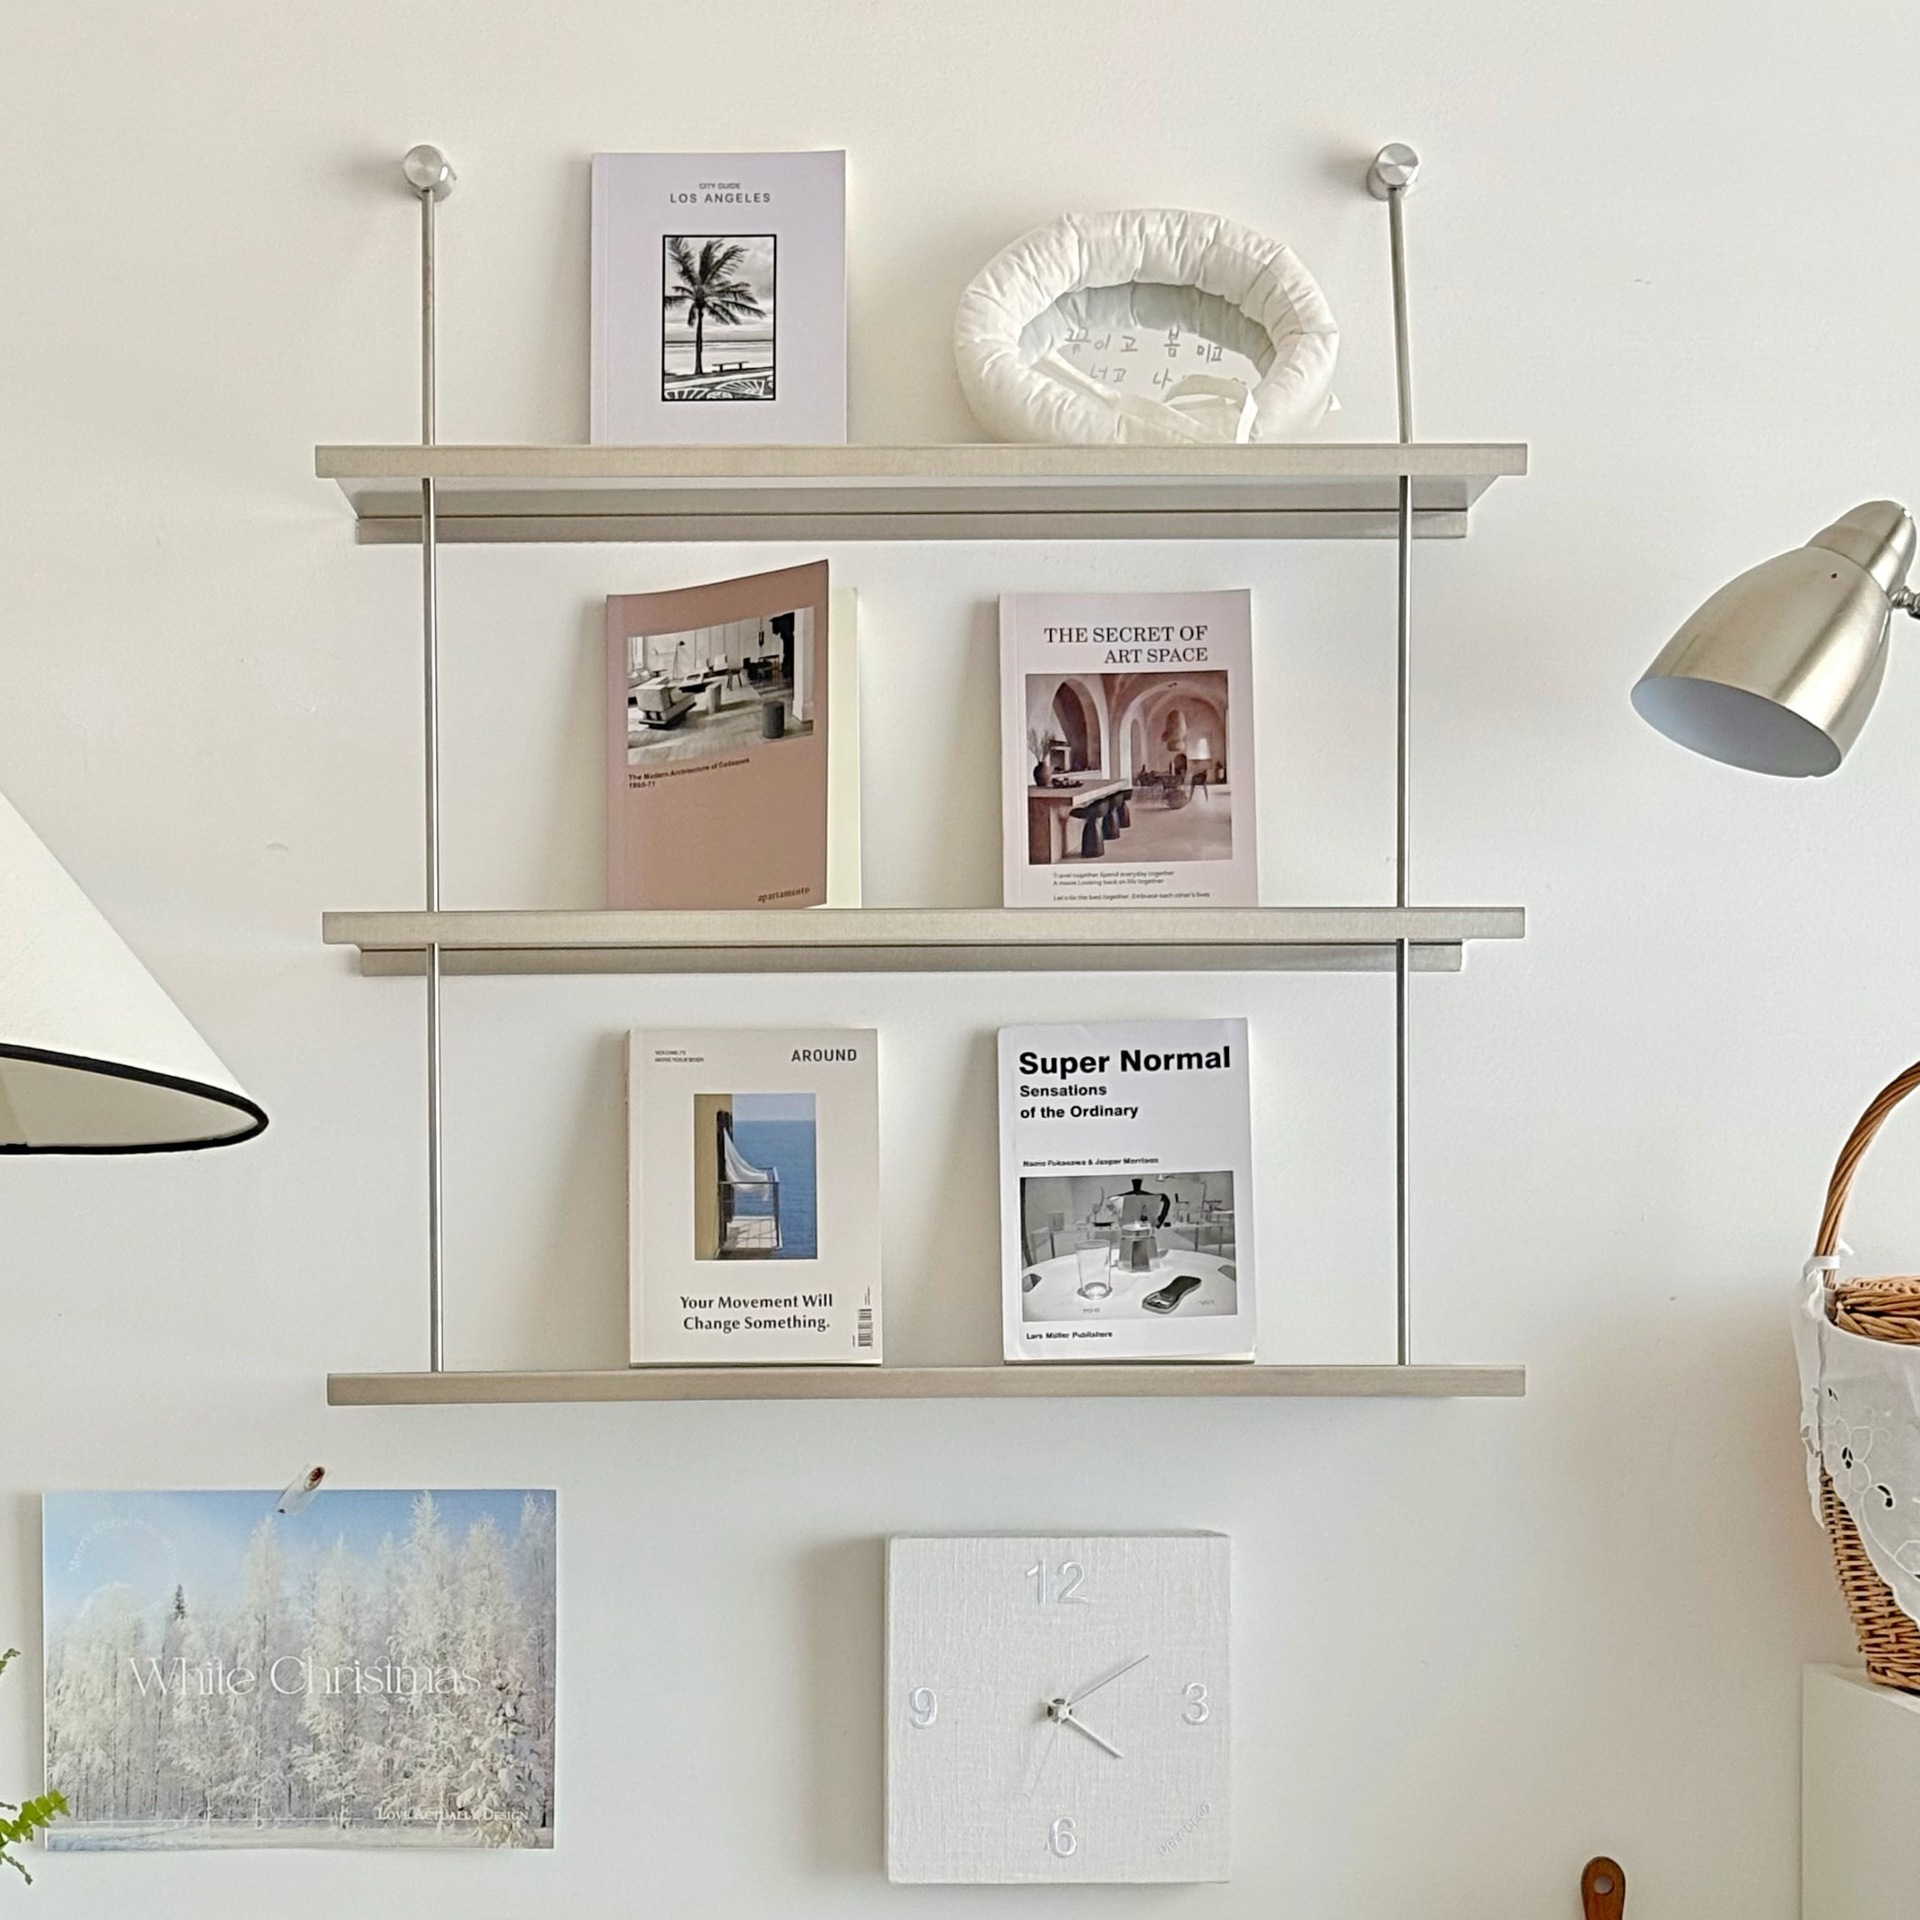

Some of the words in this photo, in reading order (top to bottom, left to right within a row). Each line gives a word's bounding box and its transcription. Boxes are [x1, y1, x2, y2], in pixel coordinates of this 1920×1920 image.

[670, 193, 697, 204] LOS
[704, 193, 771, 204] ANGELES
[1044, 627, 1088, 643] THE
[1093, 626, 1175, 643] SECRET
[1179, 625, 1208, 642] OF
[1104, 649, 1142, 664] ART
[1146, 647, 1208, 663] SPACE
[758, 887, 810, 904] apartamento
[791, 1048, 858, 1062] AROUND
[1019, 1051, 1110, 1080] Super
[1120, 1045, 1231, 1073] Normal
[1020, 1084, 1107, 1097] Sensations
[1020, 1106, 1036, 1119] of
[1040, 1106, 1065, 1118] the
[1070, 1105, 1138, 1119] Ordinary
[680, 1296, 714, 1309] Your
[717, 1295, 798, 1309] Movement
[802, 1293, 833, 1307] Will
[683, 1316, 740, 1334] Change
[744, 1315, 830, 1332] Something.
[1072, 1331, 1113, 1339] Publishers
[1025, 1559, 1088, 1604] 12
[129, 1656, 256, 1696] White
[269, 1655, 482, 1696] Christmas
[909, 1687, 938, 1729] 9
[1181, 1682, 1210, 1725] 3
[483, 1807, 529, 1821] DESIGN
[1048, 1816, 1078, 1858] 6
